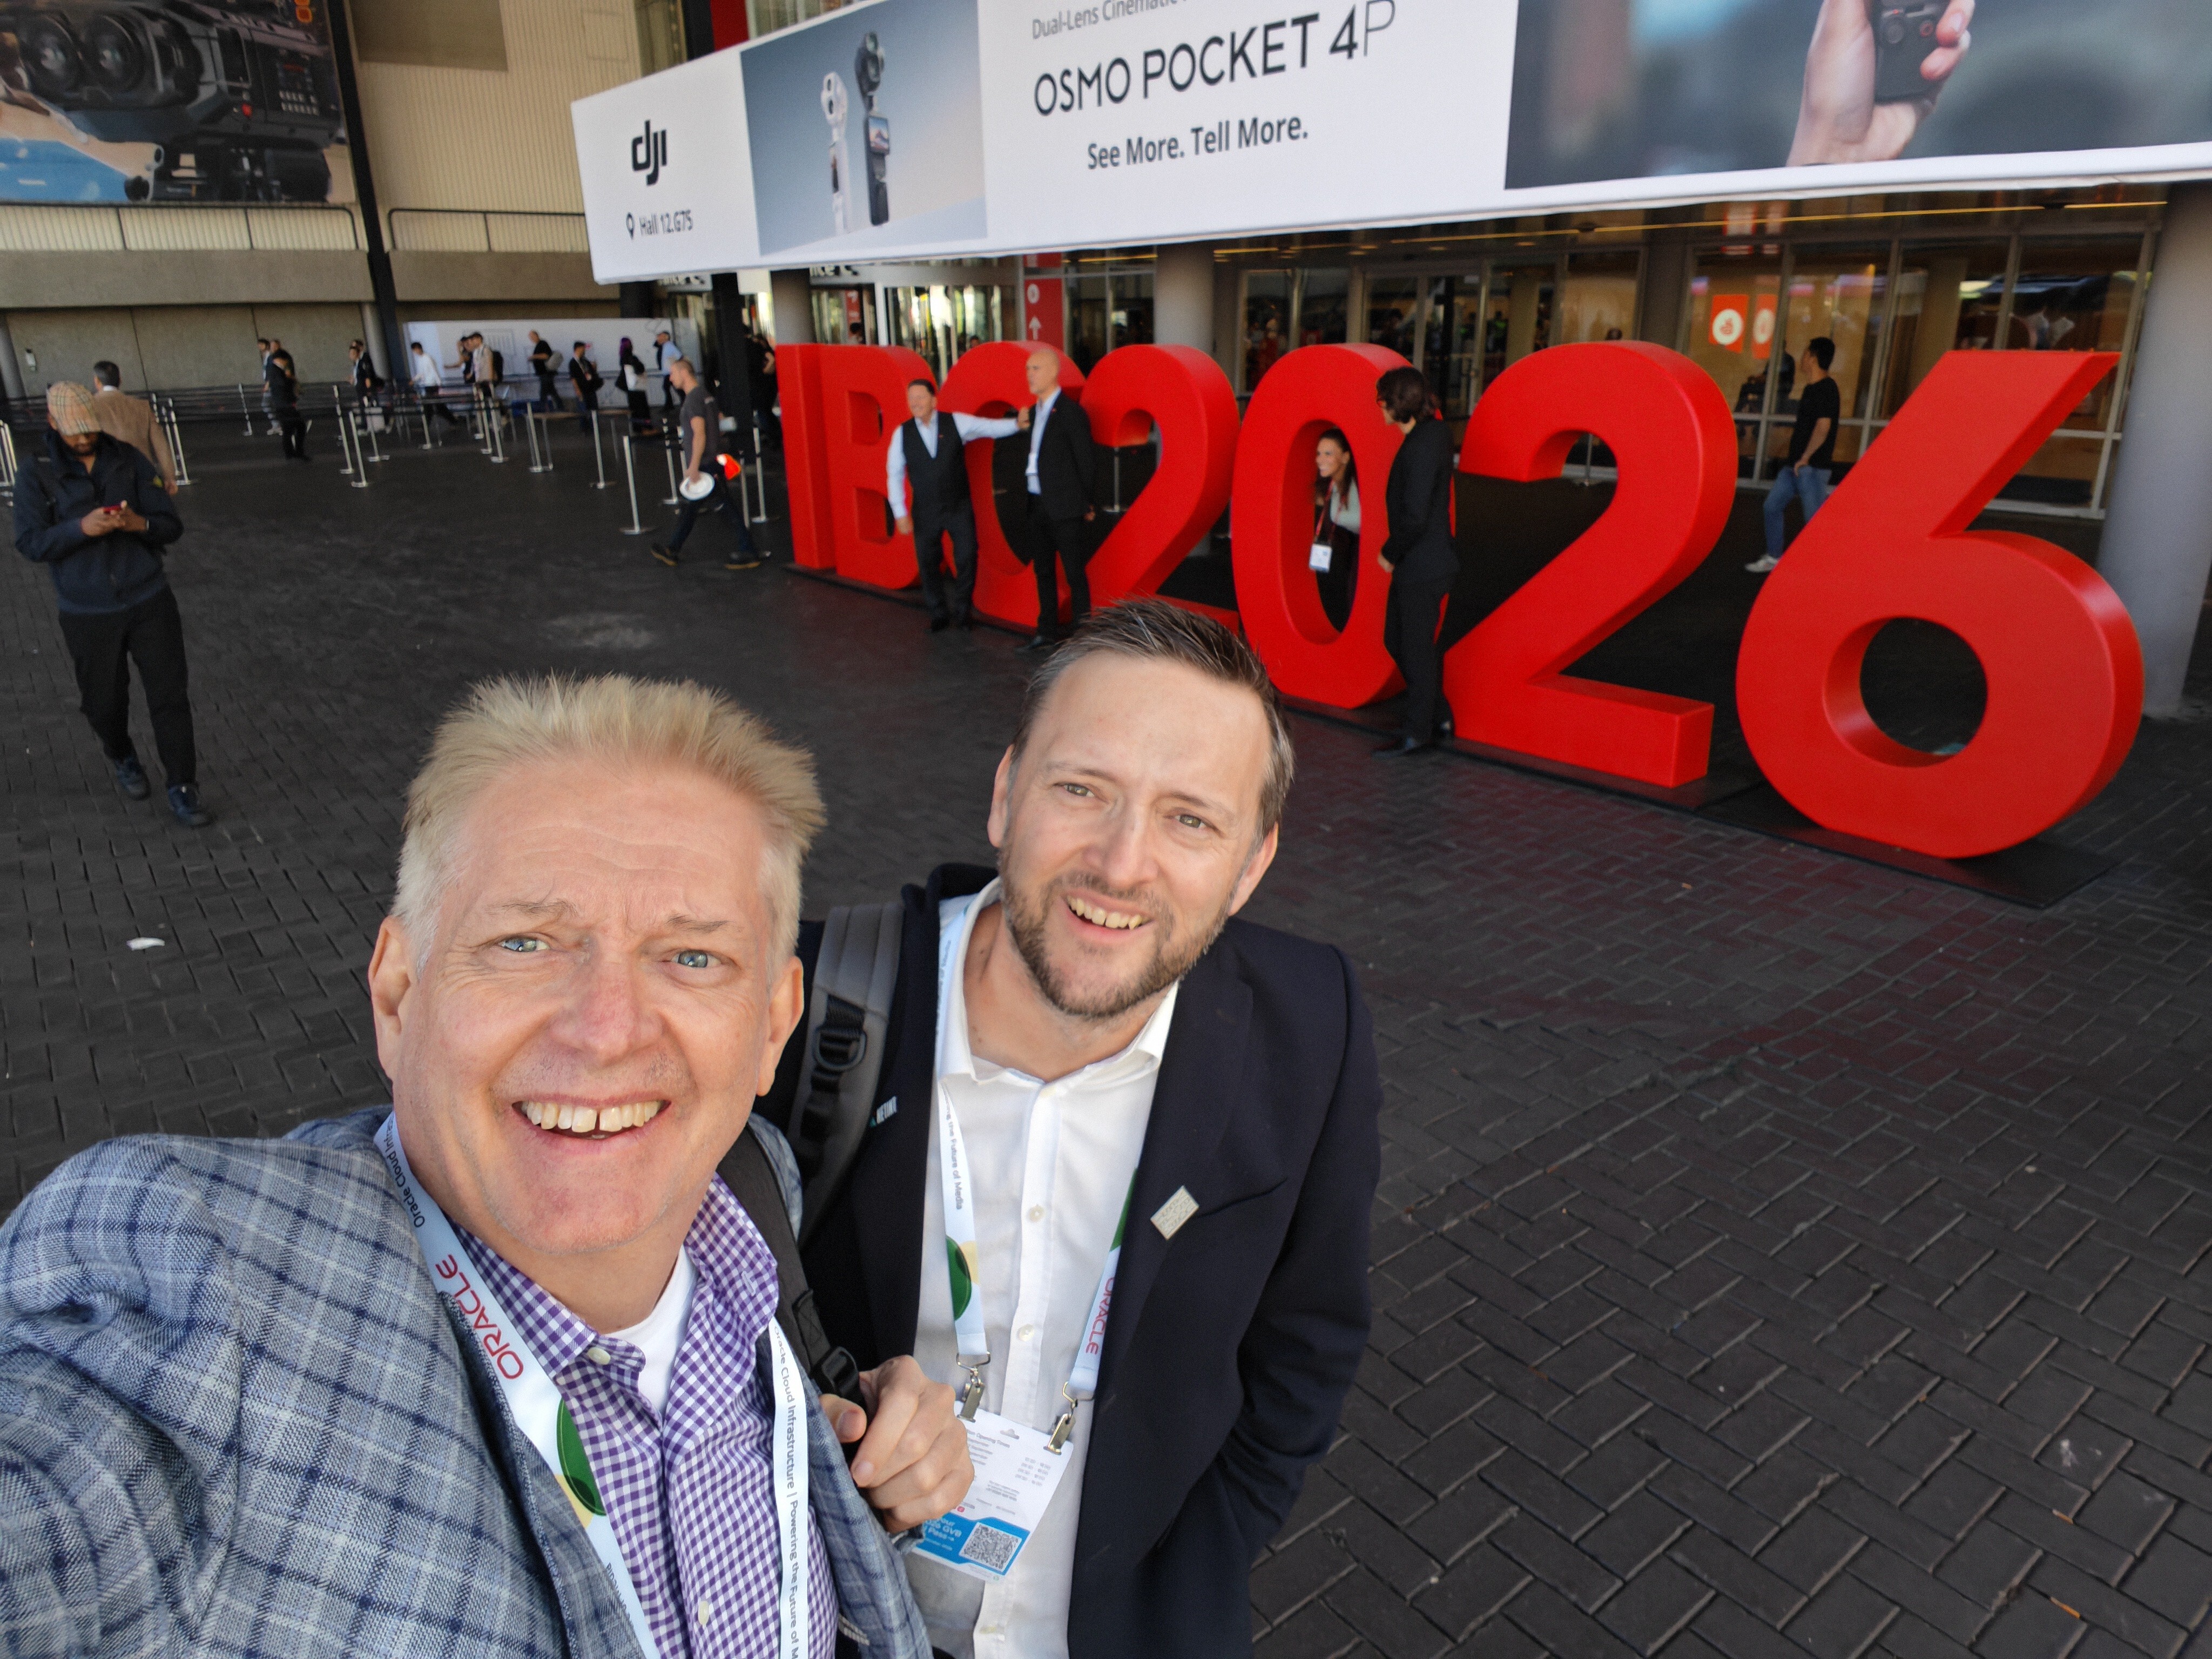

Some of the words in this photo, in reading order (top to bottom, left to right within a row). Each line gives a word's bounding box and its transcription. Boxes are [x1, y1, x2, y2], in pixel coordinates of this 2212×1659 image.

[1032, 6, 1100, 39] Dual-Lens
[1034, 57, 1131, 116] OSMO
[1143, 12, 1320, 99] POCKET
[1329, 0, 1395, 59] 4P
[1087, 143, 1121, 170] See
[1126, 136, 1185, 165] More.
[1191, 120, 1230, 156] Tell
[1238, 116, 1309, 149] More.
[639, 213, 658, 237] Hall
[660, 209, 693, 234] 12.G75
[387, 1150, 406, 1187] Cloud
[952, 1170, 961, 1179] of
[403, 1187, 425, 1228] Oracle
[954, 1182, 963, 1210] Media
[435, 1254, 524, 1380] ORACLE
[774, 1326, 786, 1365] Oracle
[781, 1366, 795, 1403] Cloud
[786, 1405, 797, 1489] Infrastructure
[790, 1500, 798, 1561] Powering
[789, 1584, 798, 1629] Future
[791, 1631, 799, 1644] of
